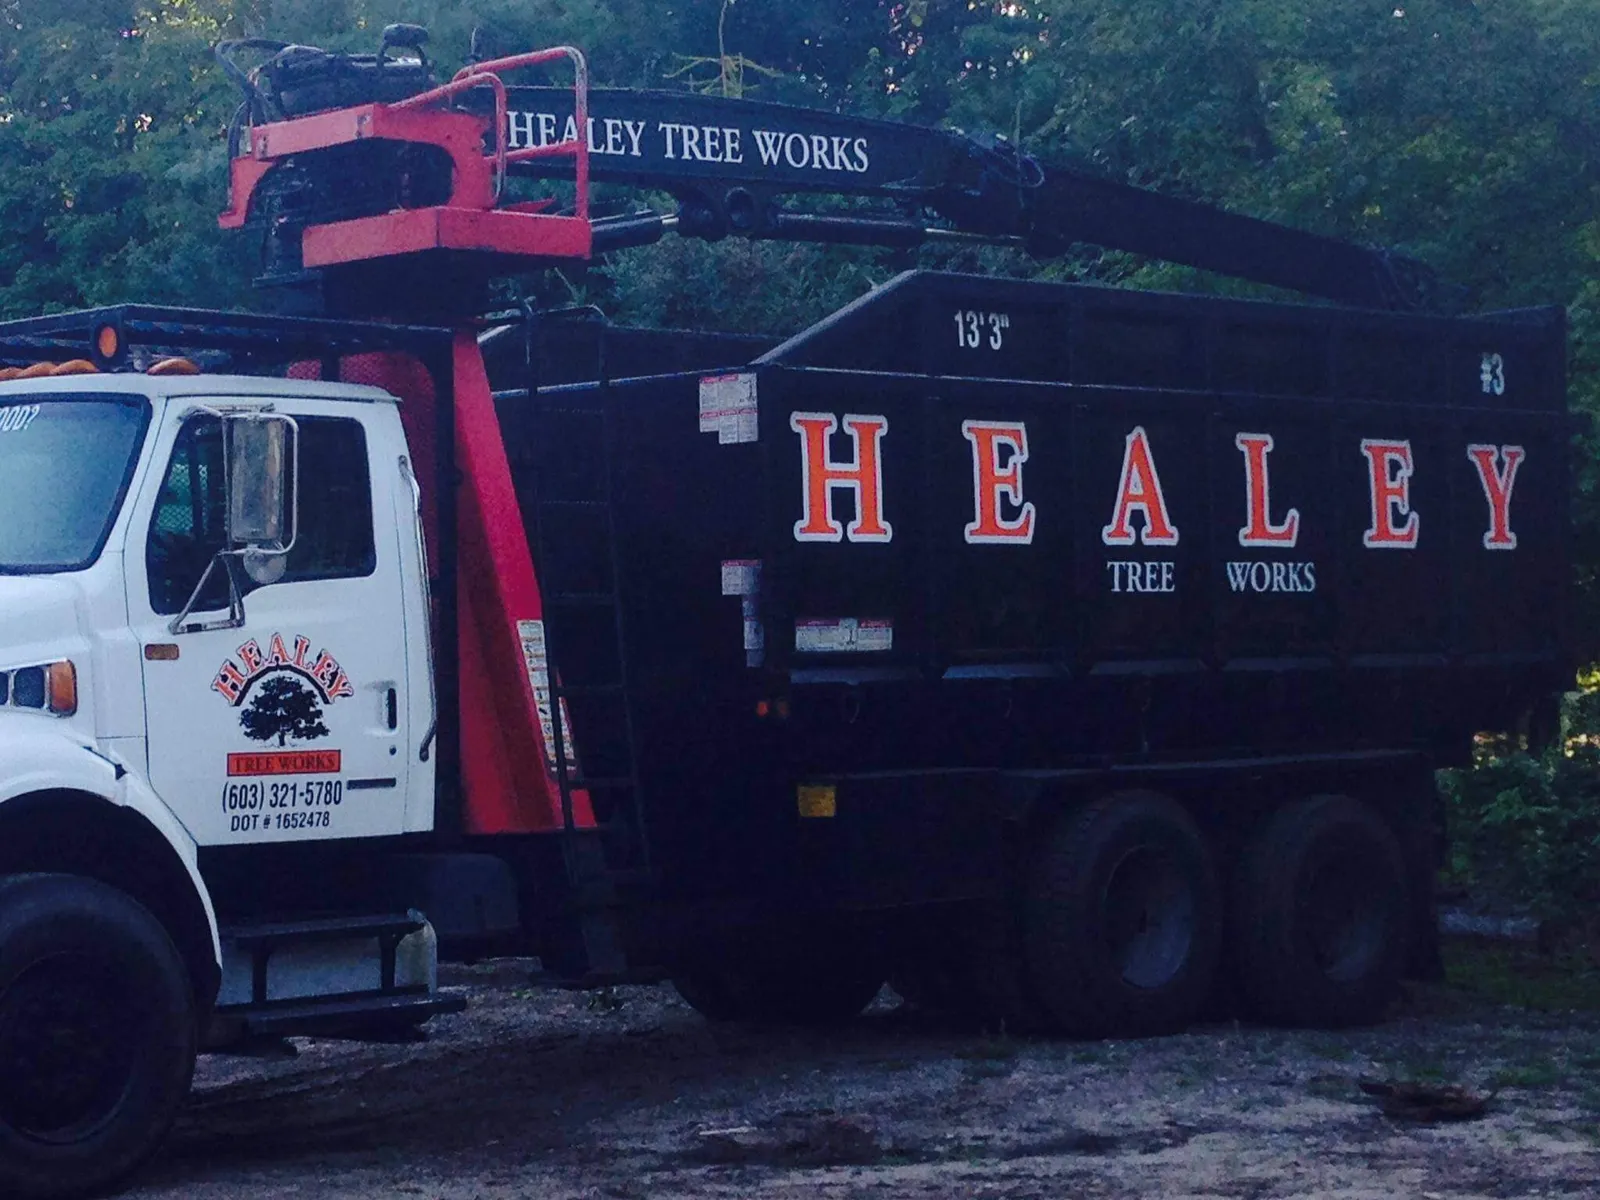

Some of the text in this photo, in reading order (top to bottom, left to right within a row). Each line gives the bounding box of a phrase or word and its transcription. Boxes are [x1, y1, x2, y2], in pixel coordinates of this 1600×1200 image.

[506, 110, 869, 173] HEALEY TREE WORKS
[1480, 352, 1505, 395] #3
[789, 411, 1526, 552] HEALEY
[1107, 561, 1317, 593] TREE WORKS
[210, 632, 354, 706] HEALEY
[234, 752, 337, 773] TREE WORKS
[222, 780, 342, 813] (603) 321-5780
[231, 811, 330, 831] DOT # 1652478
